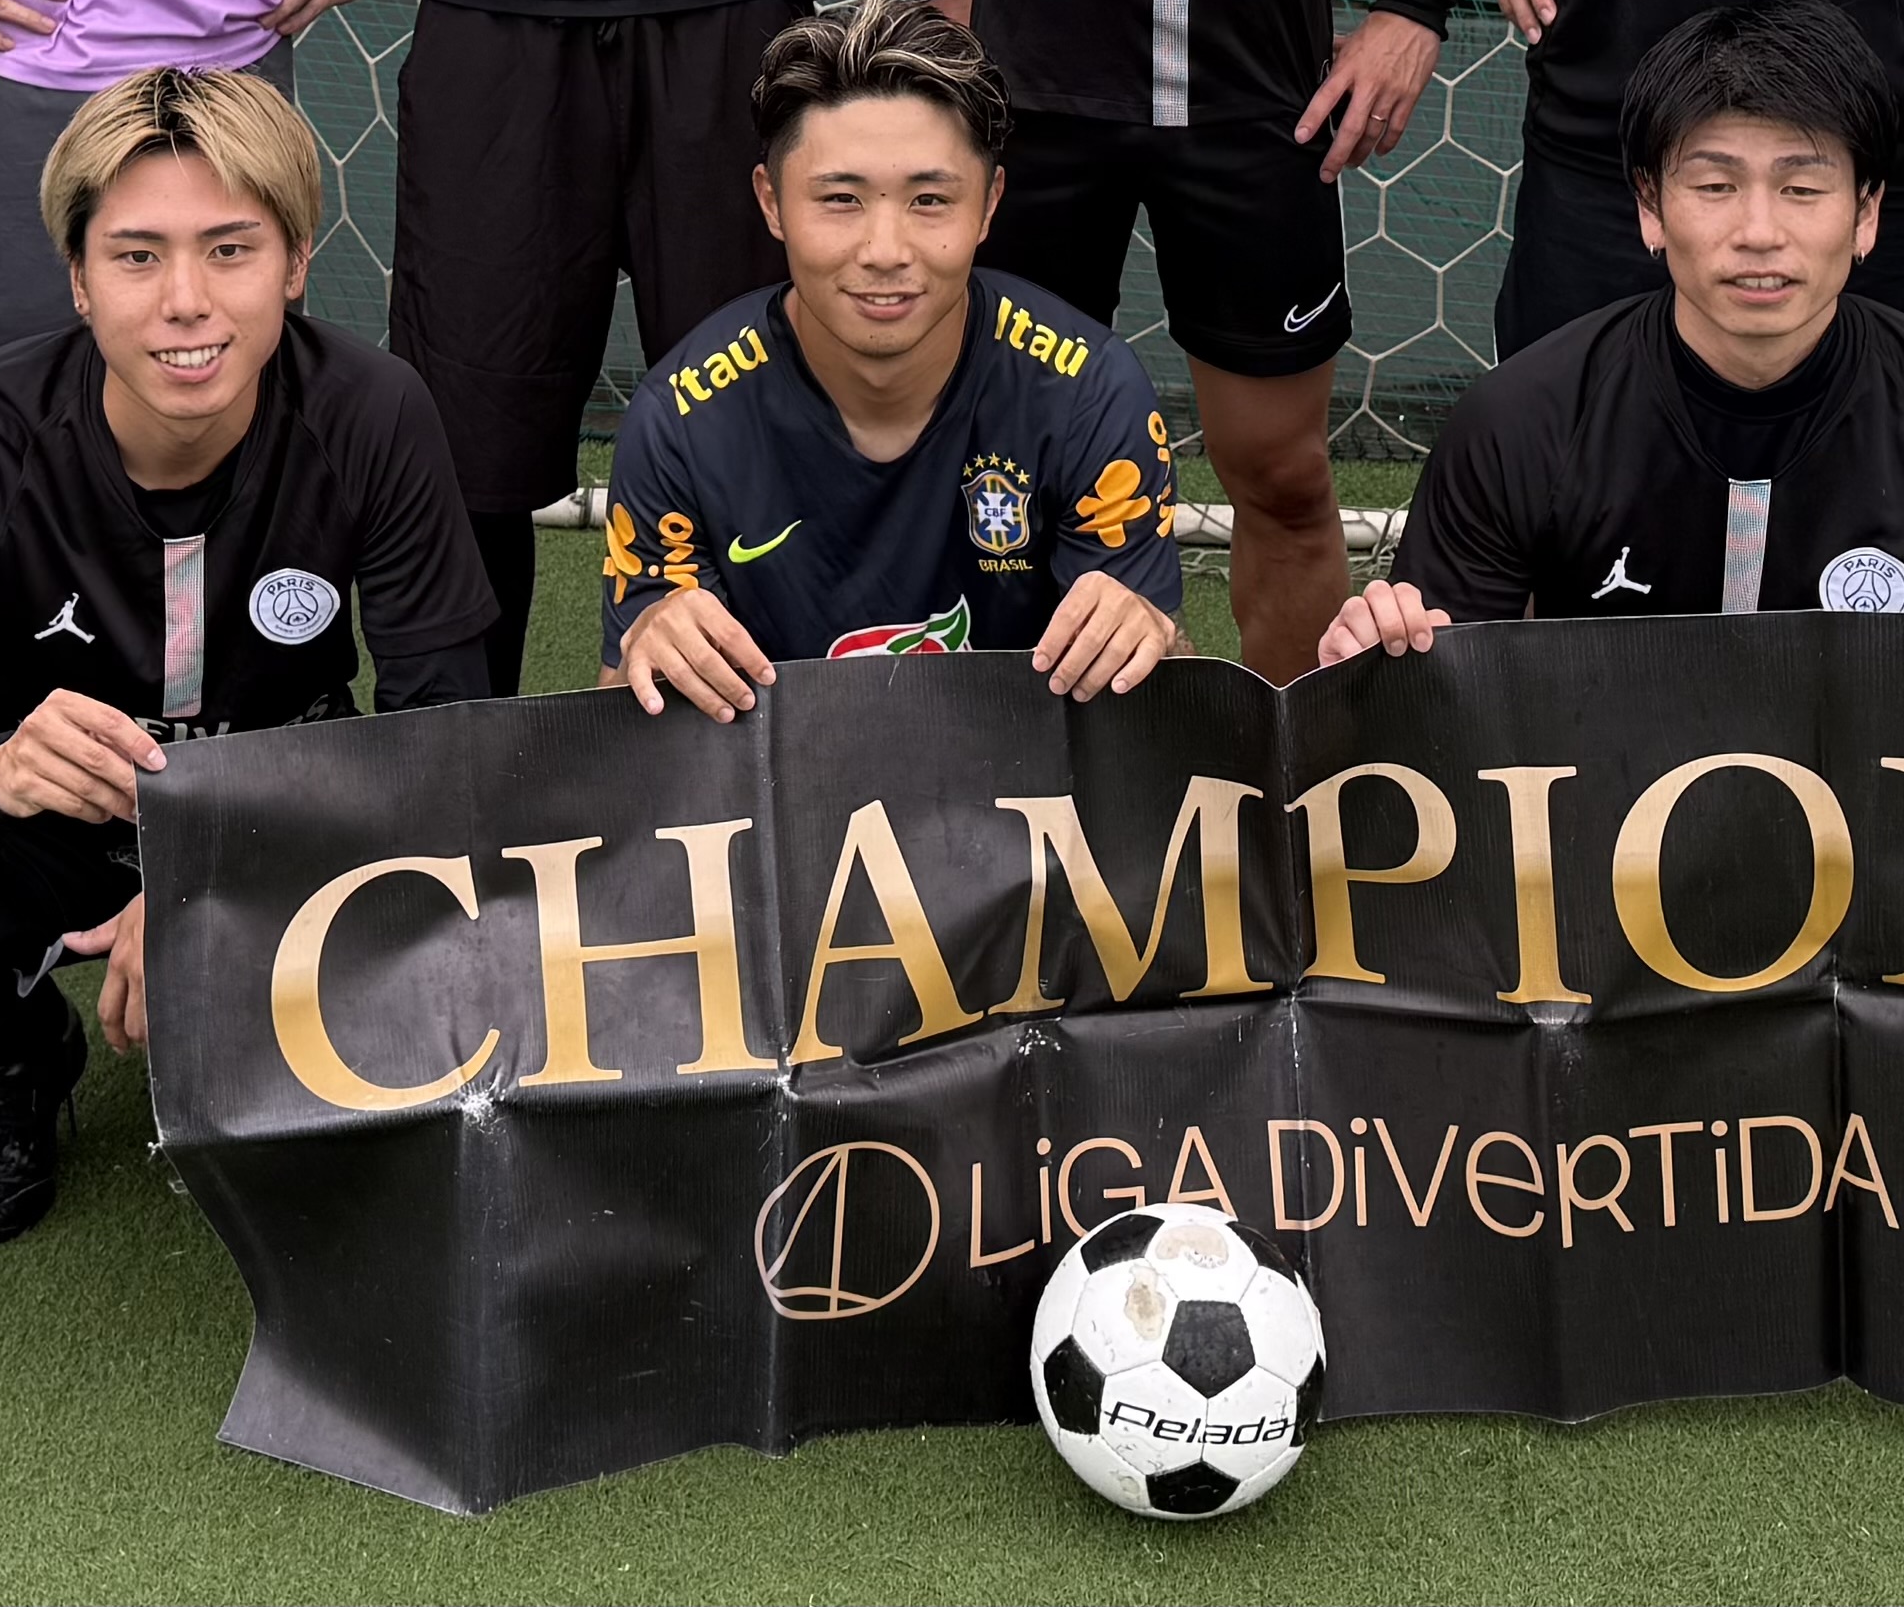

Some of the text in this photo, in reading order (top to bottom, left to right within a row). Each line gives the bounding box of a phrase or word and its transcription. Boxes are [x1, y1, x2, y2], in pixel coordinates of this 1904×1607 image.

[994, 296, 1089, 378] Itaú
[668, 325, 769, 416] Itaú
[984, 507, 1007, 518] CBF
[978, 559, 1033, 572] BRASIL
[1844, 558, 1896, 578] PARIS
[267, 578, 315, 595] PARIS
[1104, 1401, 1296, 1445] Pelada
